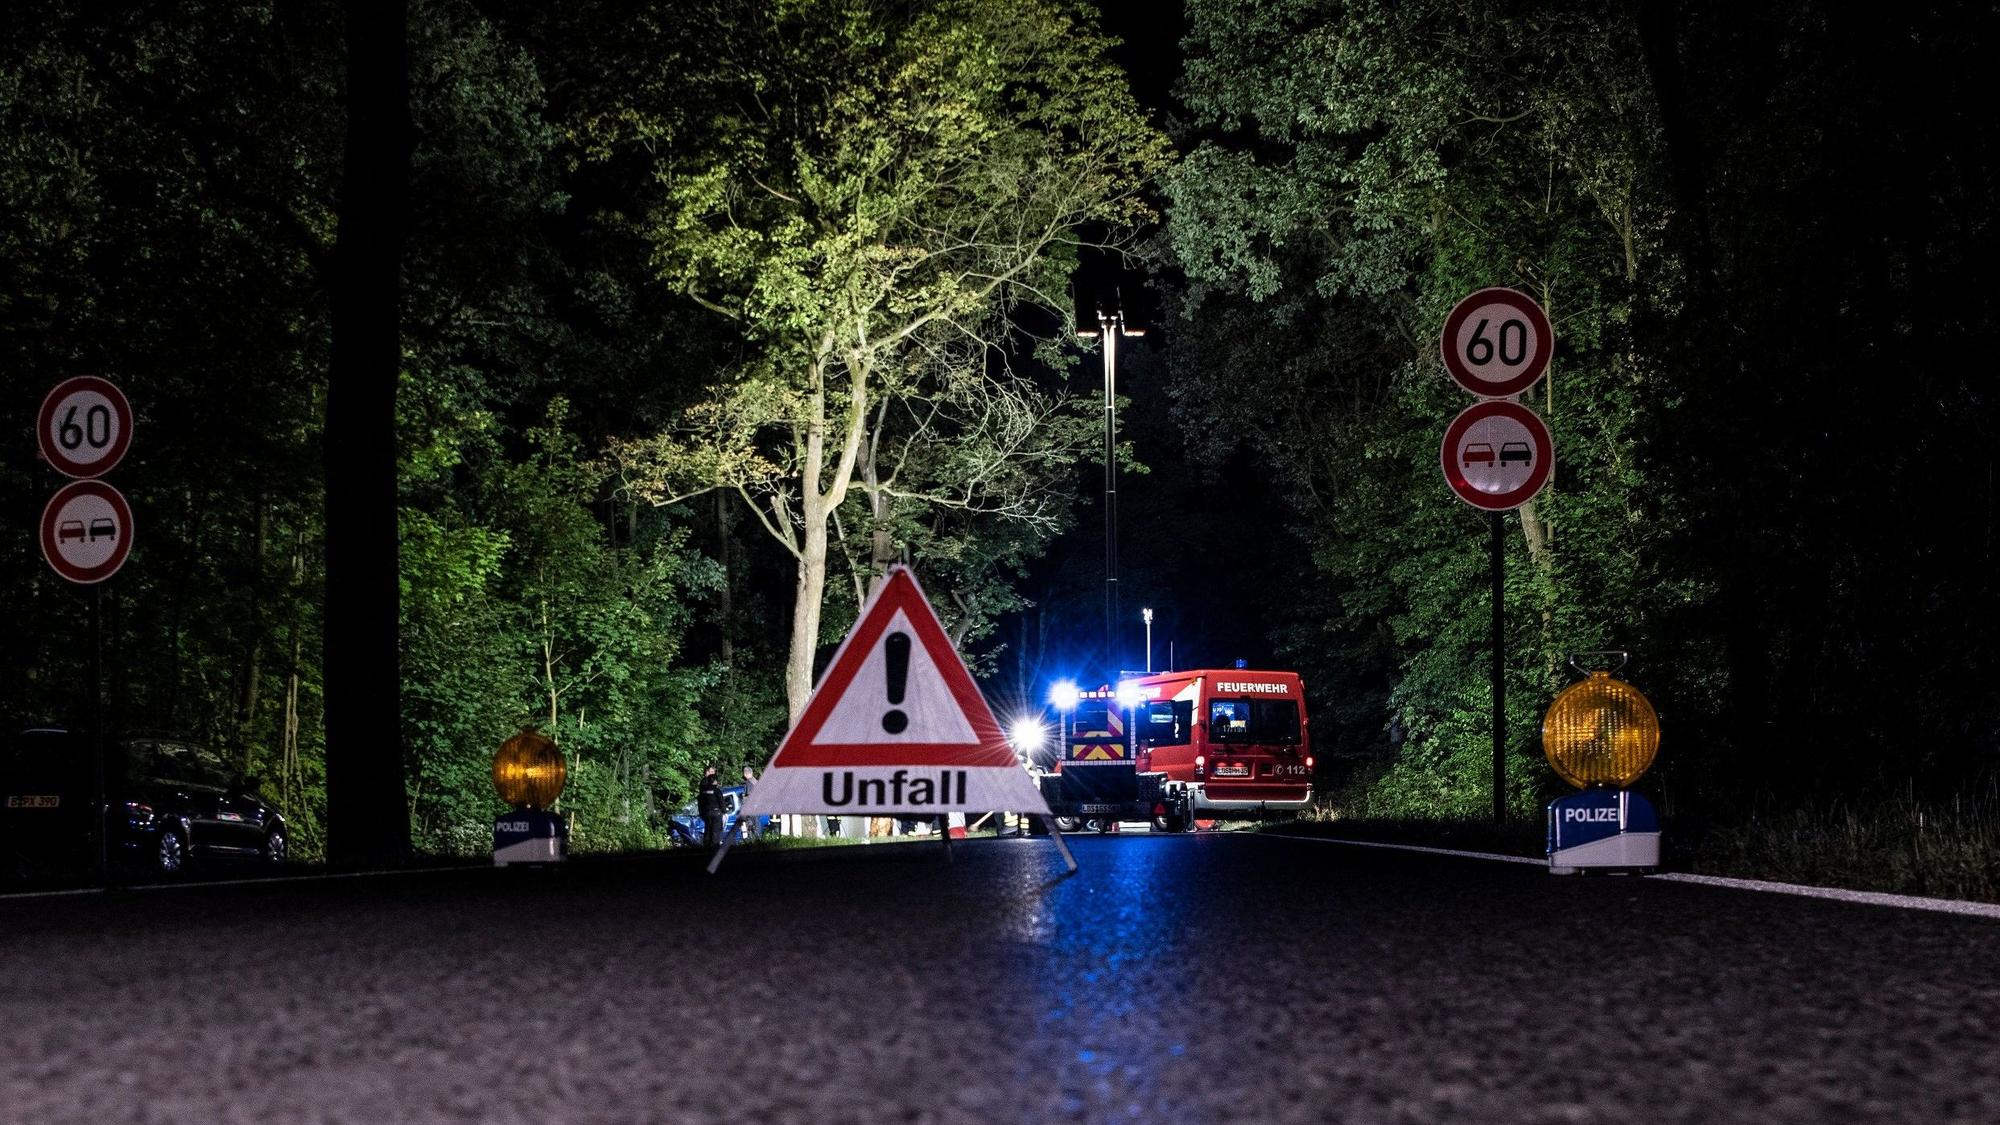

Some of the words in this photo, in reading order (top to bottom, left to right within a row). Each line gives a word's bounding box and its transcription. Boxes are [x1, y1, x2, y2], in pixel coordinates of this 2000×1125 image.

[1466, 319, 1527, 367] 60
[60, 405, 111, 450] 60
[1216, 682, 1289, 694] FEUERWEHR
[1286, 765, 1306, 775] 112
[822, 769, 968, 807] Unfall
[1565, 807, 1622, 823] POLIZEI
[496, 820, 530, 833] POLIZEI
